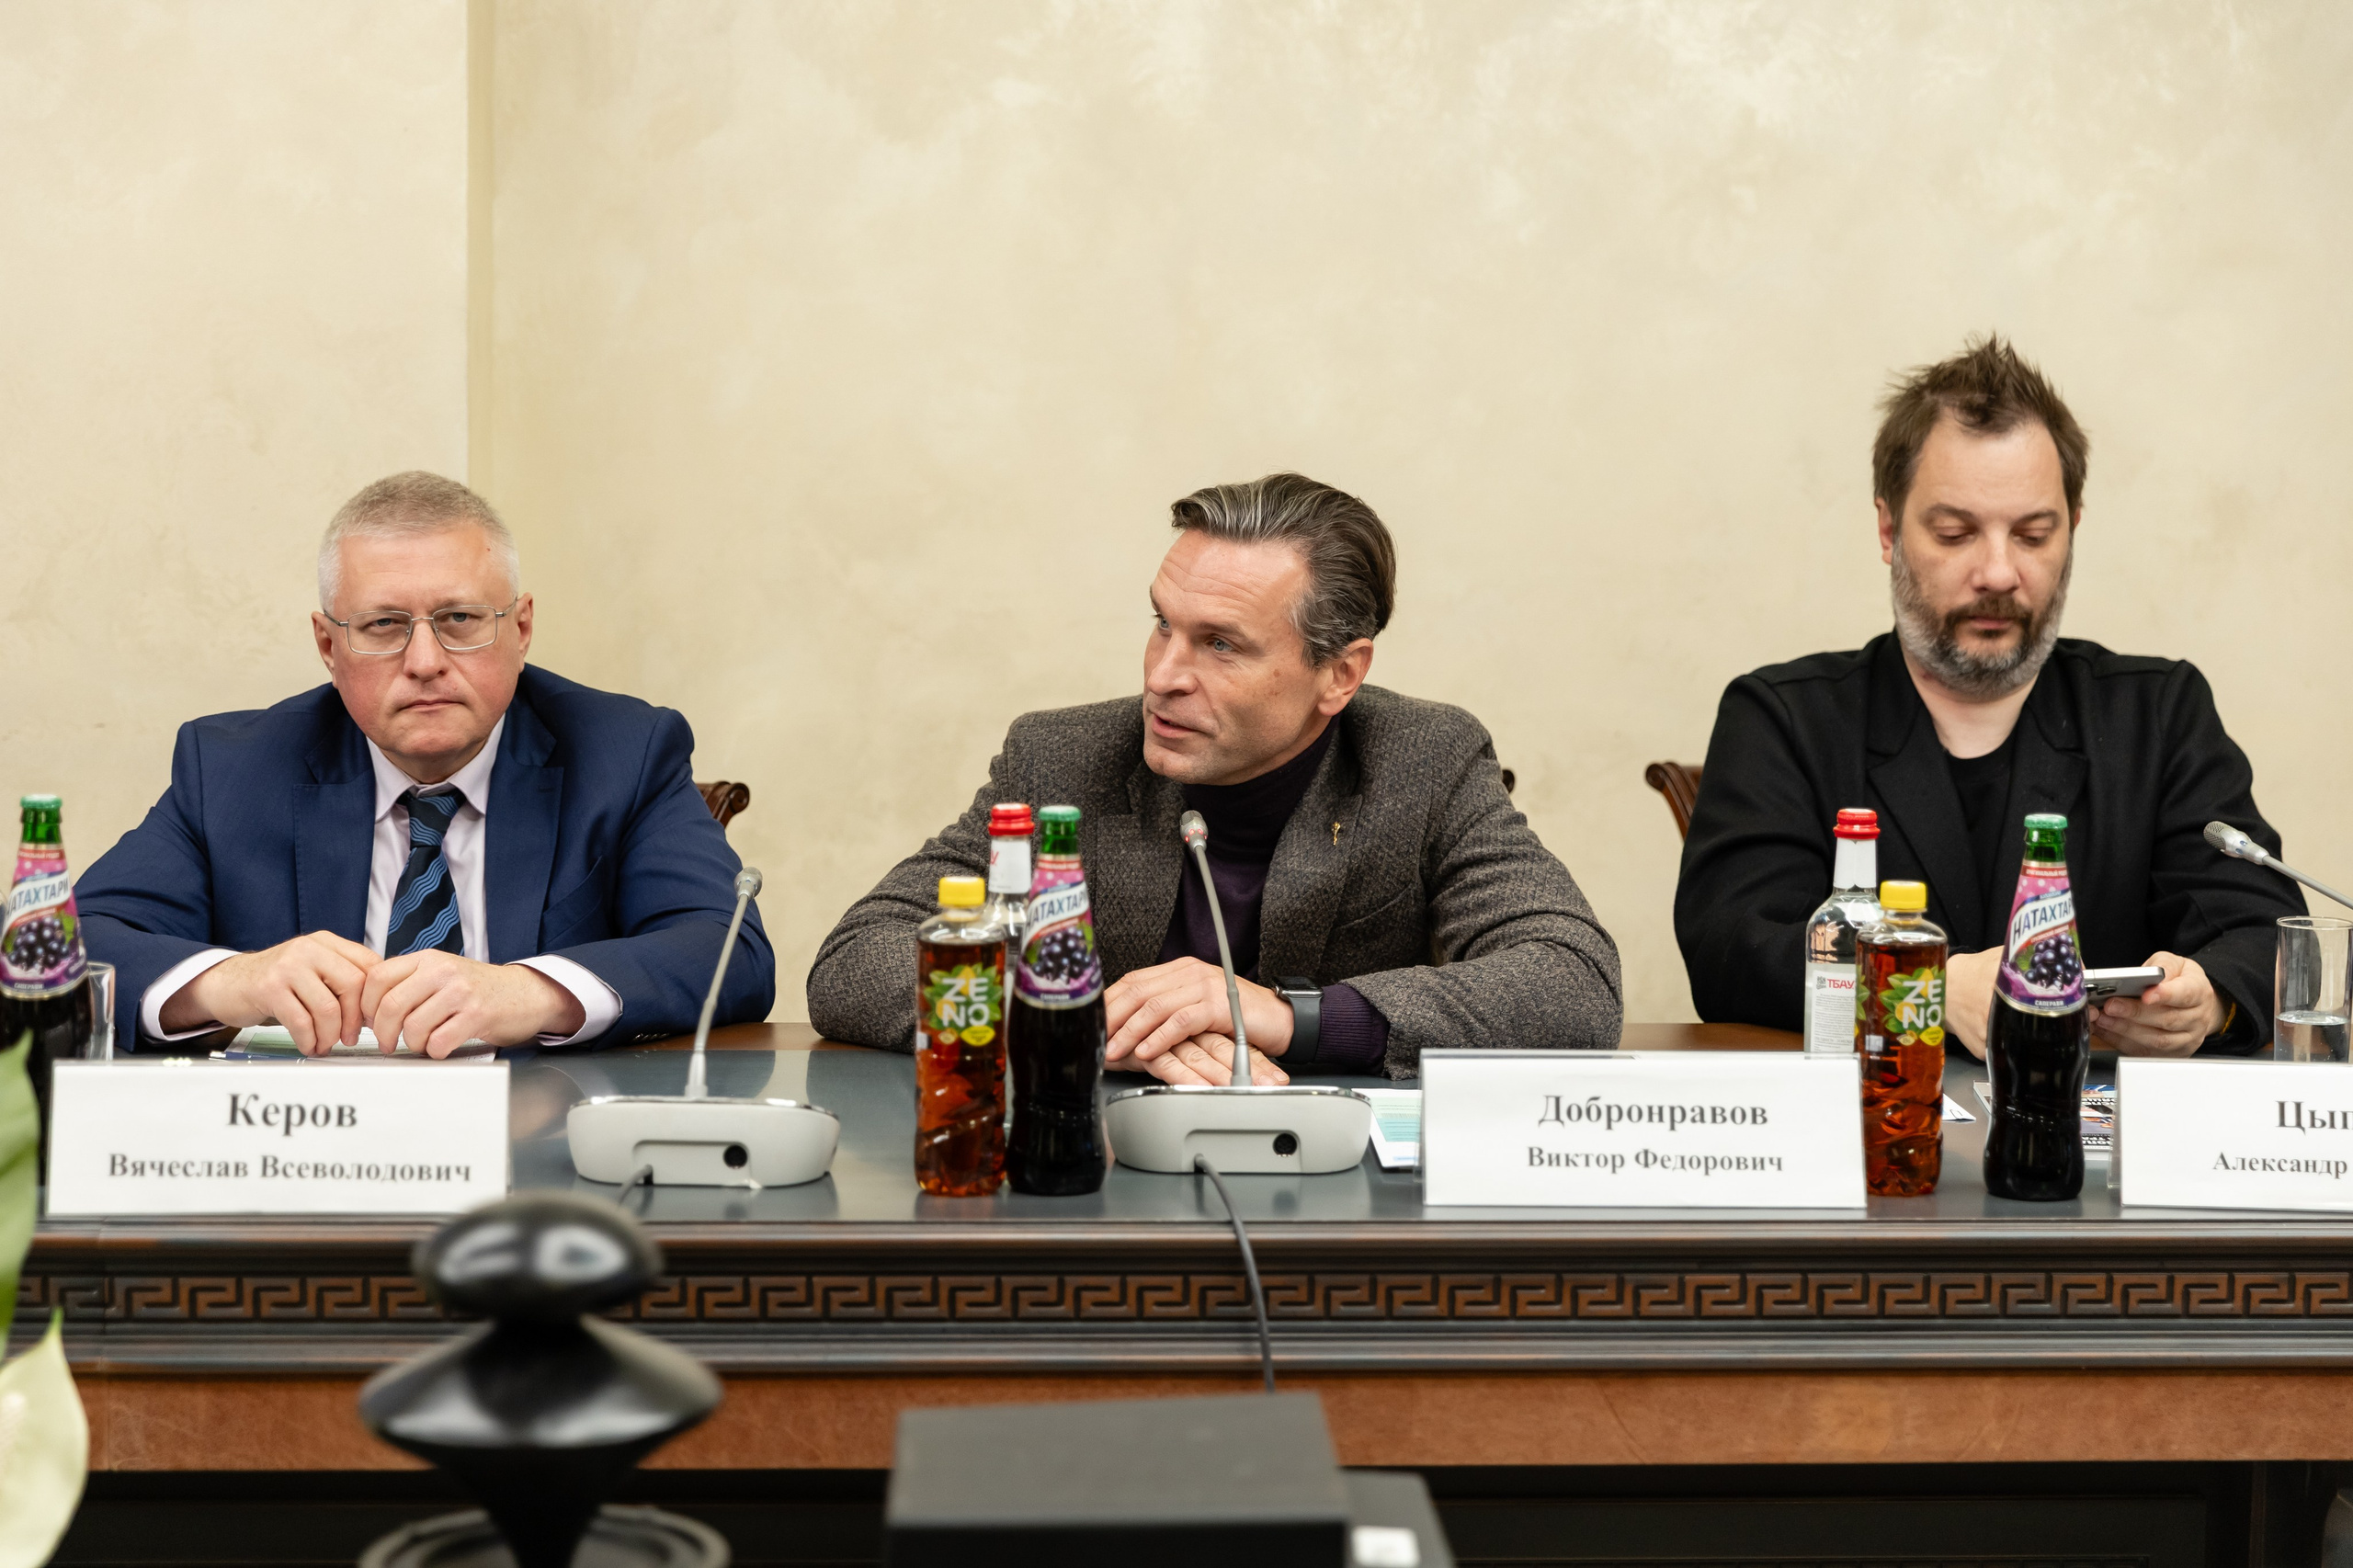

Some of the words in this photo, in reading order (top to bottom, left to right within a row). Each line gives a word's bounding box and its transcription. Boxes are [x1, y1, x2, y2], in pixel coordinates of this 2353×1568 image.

[942, 977, 988, 1002] ZE
[1903, 979, 1942, 1004] ZE
[942, 1003, 990, 1028] NO
[1902, 1004, 1942, 1029] NO
[227, 1094, 358, 1137] Керов
[1538, 1095, 1768, 1131] Добронравов
[2275, 1100, 2353, 1136] Цып
[108, 1153, 249, 1177] Вячеслав
[260, 1155, 471, 1182] Всеволодович
[1528, 1146, 1625, 1174] Виктор
[1634, 1148, 1782, 1176] Федорович
[2212, 1152, 2348, 1180] Александр
